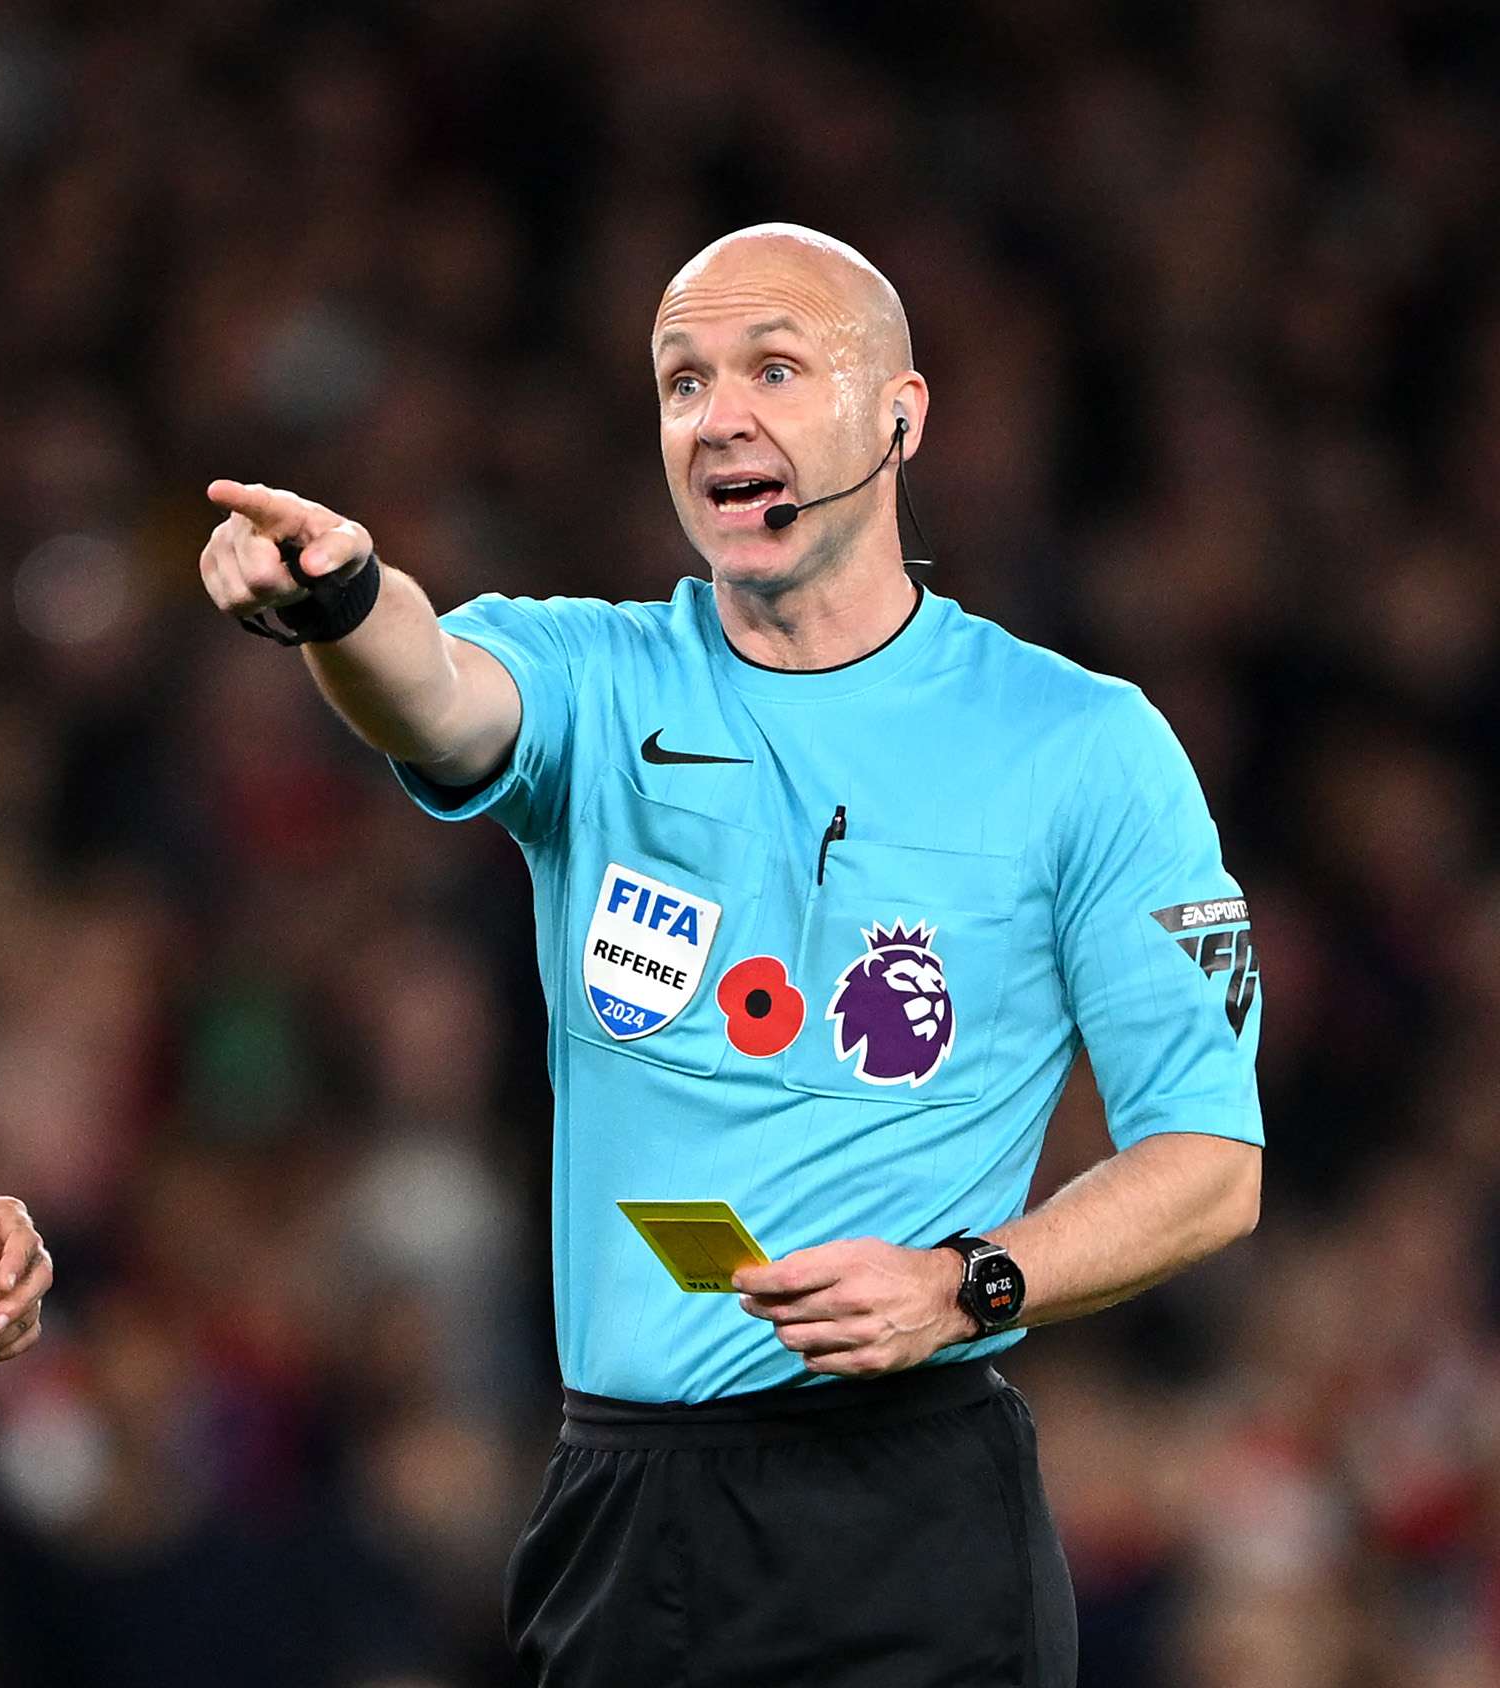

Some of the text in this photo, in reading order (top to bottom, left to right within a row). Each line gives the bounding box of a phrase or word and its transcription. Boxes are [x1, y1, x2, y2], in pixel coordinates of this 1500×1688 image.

[607, 878, 698, 946] FIFA
[1182, 900, 1249, 926] EA SPORT
[593, 939, 687, 990] REFEREE
[602, 998, 647, 1029] 2024
[985, 1277, 1012, 1295] 32:40
